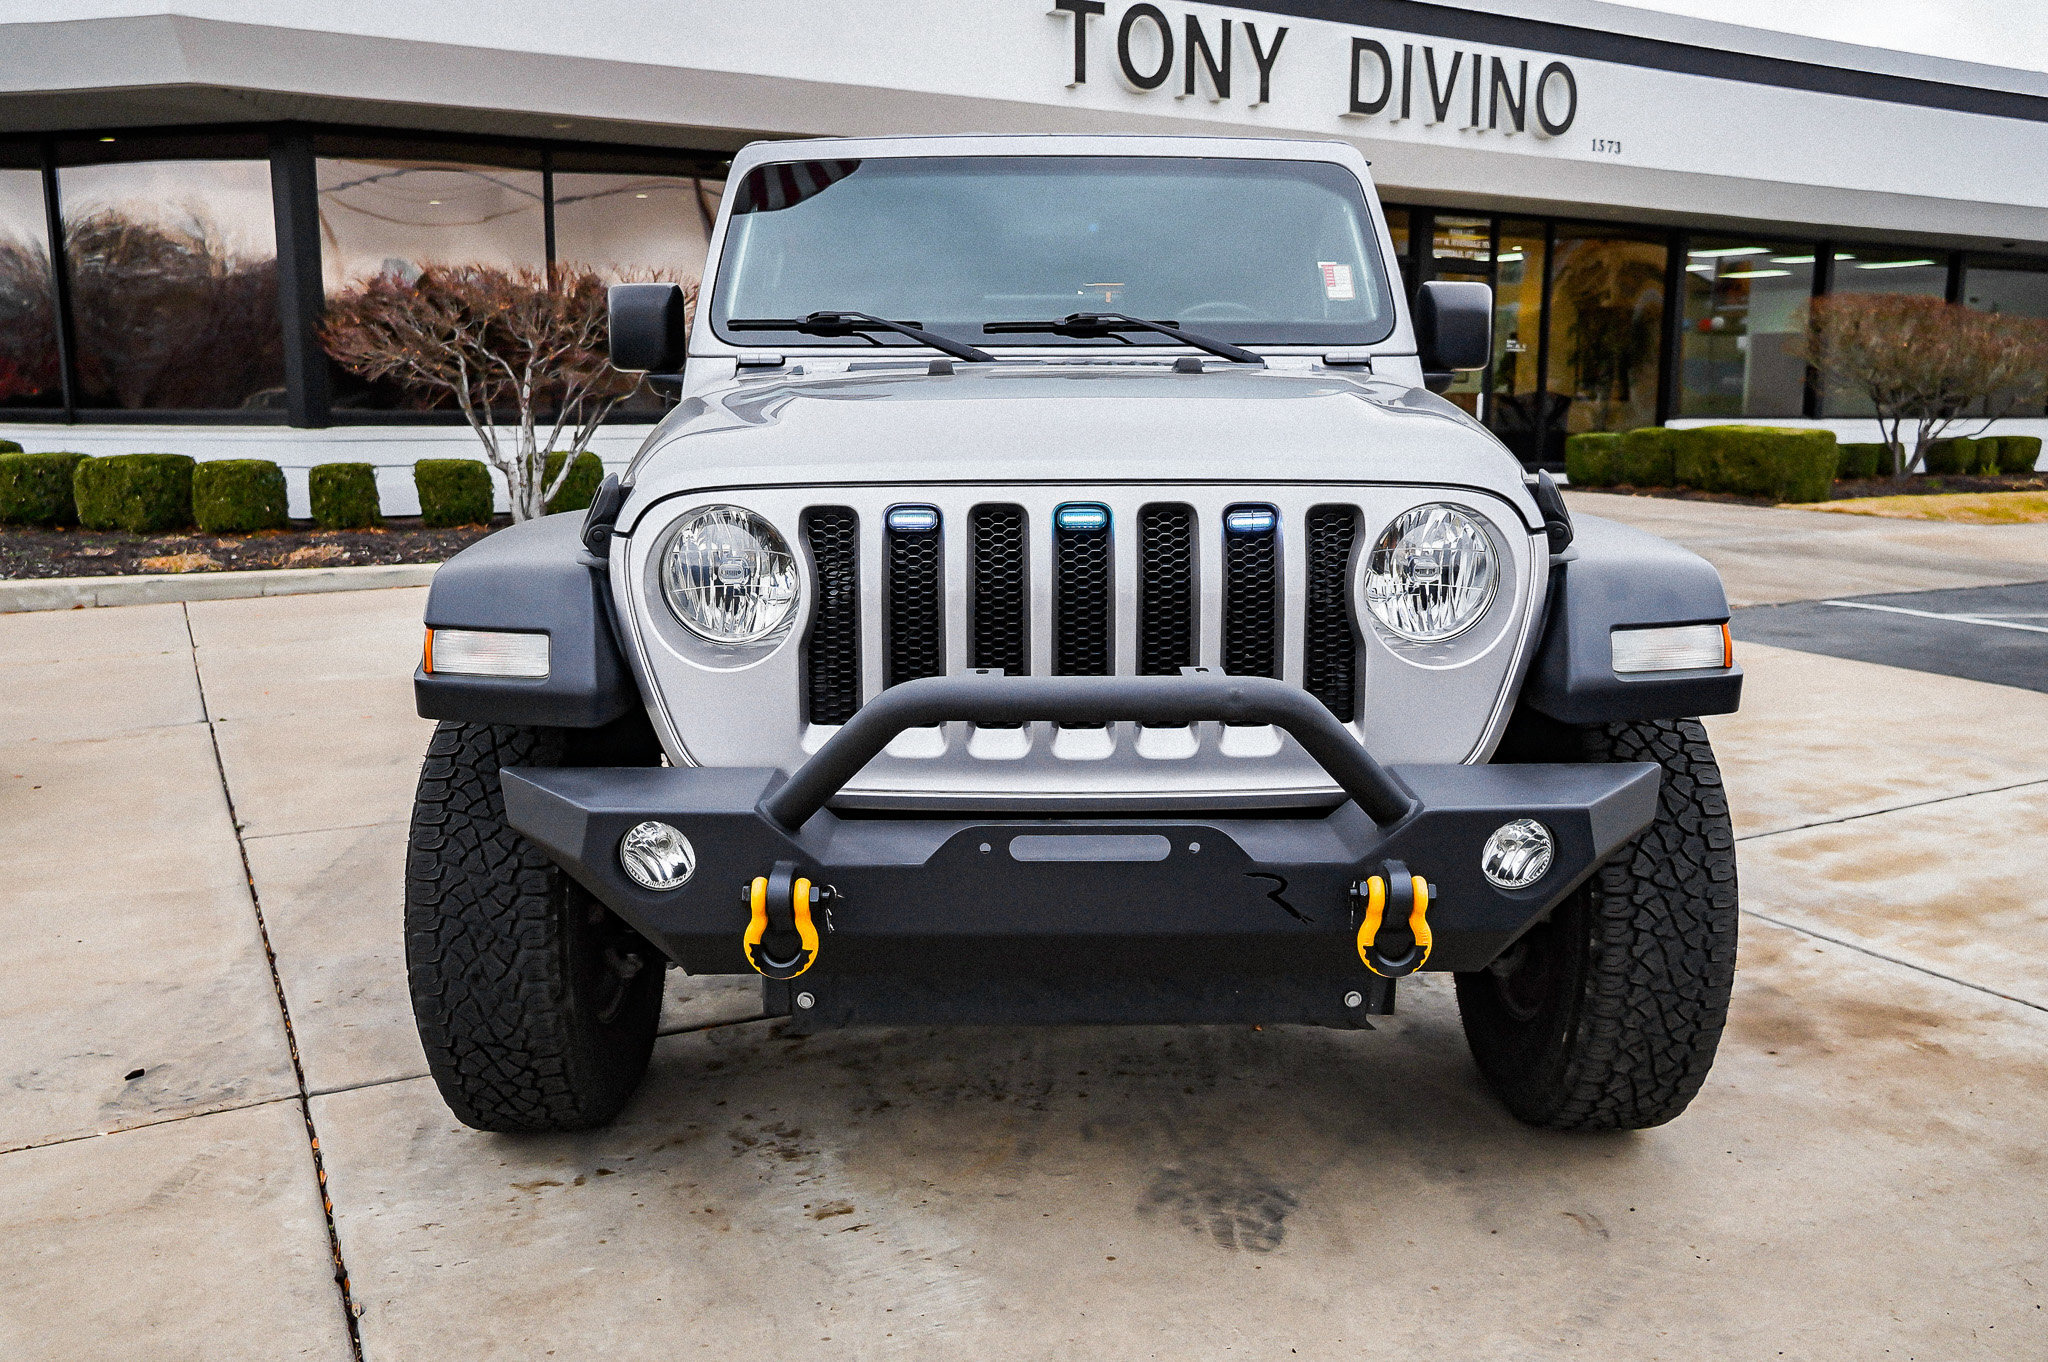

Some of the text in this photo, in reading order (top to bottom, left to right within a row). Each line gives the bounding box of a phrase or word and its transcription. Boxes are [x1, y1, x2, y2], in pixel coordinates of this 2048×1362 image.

[1056, 0, 1577, 136] TONY DIVINO
[1591, 138, 1621, 154] 1573
